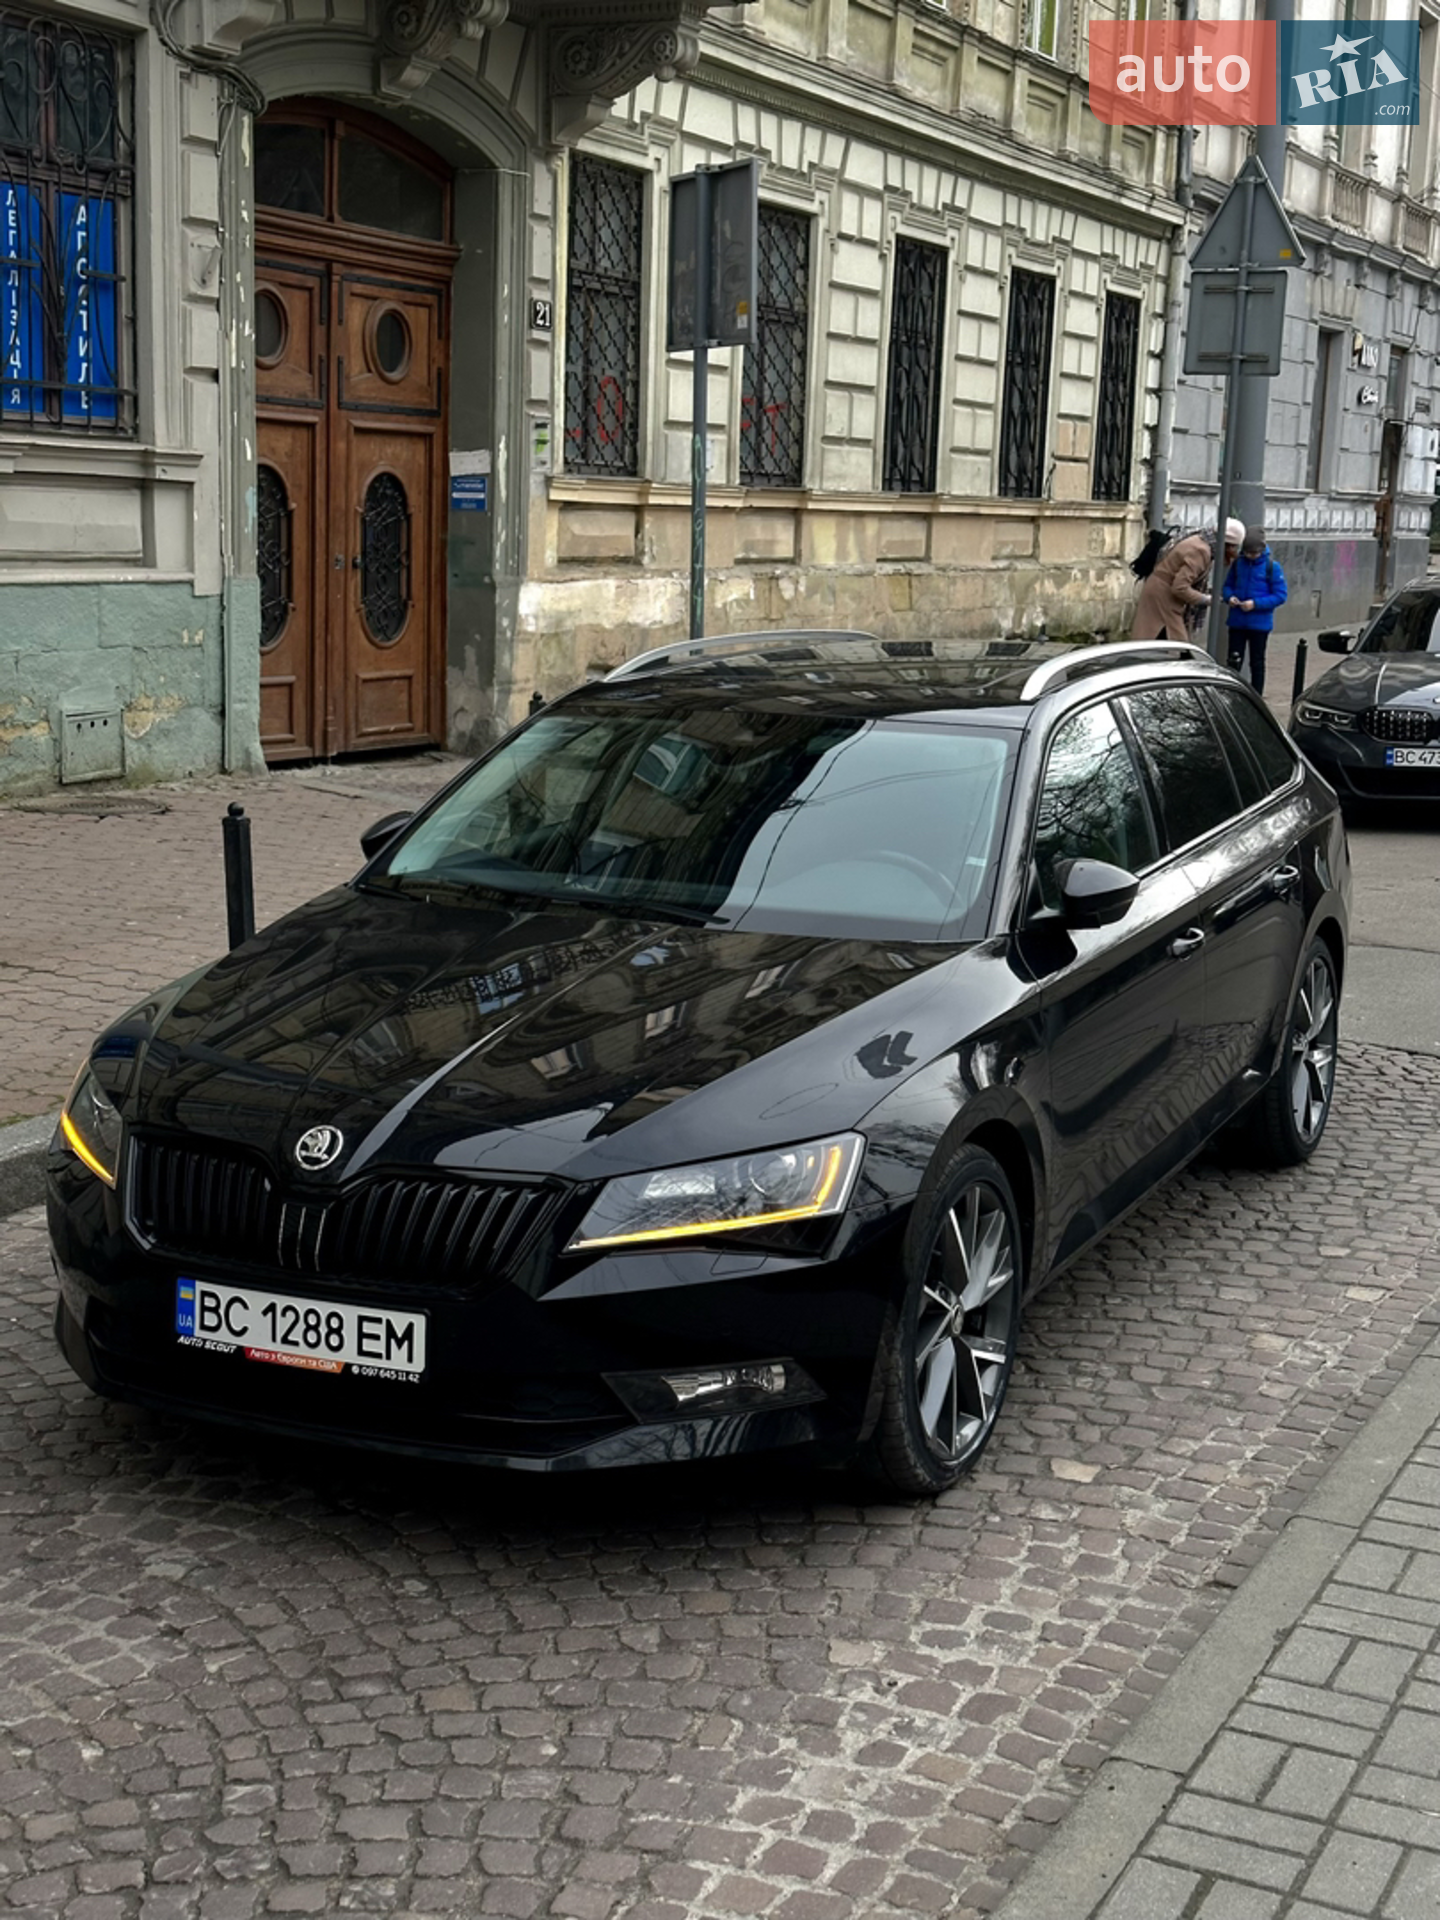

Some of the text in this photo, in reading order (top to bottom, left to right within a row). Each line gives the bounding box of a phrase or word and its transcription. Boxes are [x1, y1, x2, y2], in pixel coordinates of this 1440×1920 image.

[535, 301, 551, 327] 21
[1394, 750, 1416, 765] BC
[178, 1313, 193, 1329] UA
[199, 1289, 415, 1364] BC 1288 EM
[177, 1335, 237, 1354] AUTO SCOUT
